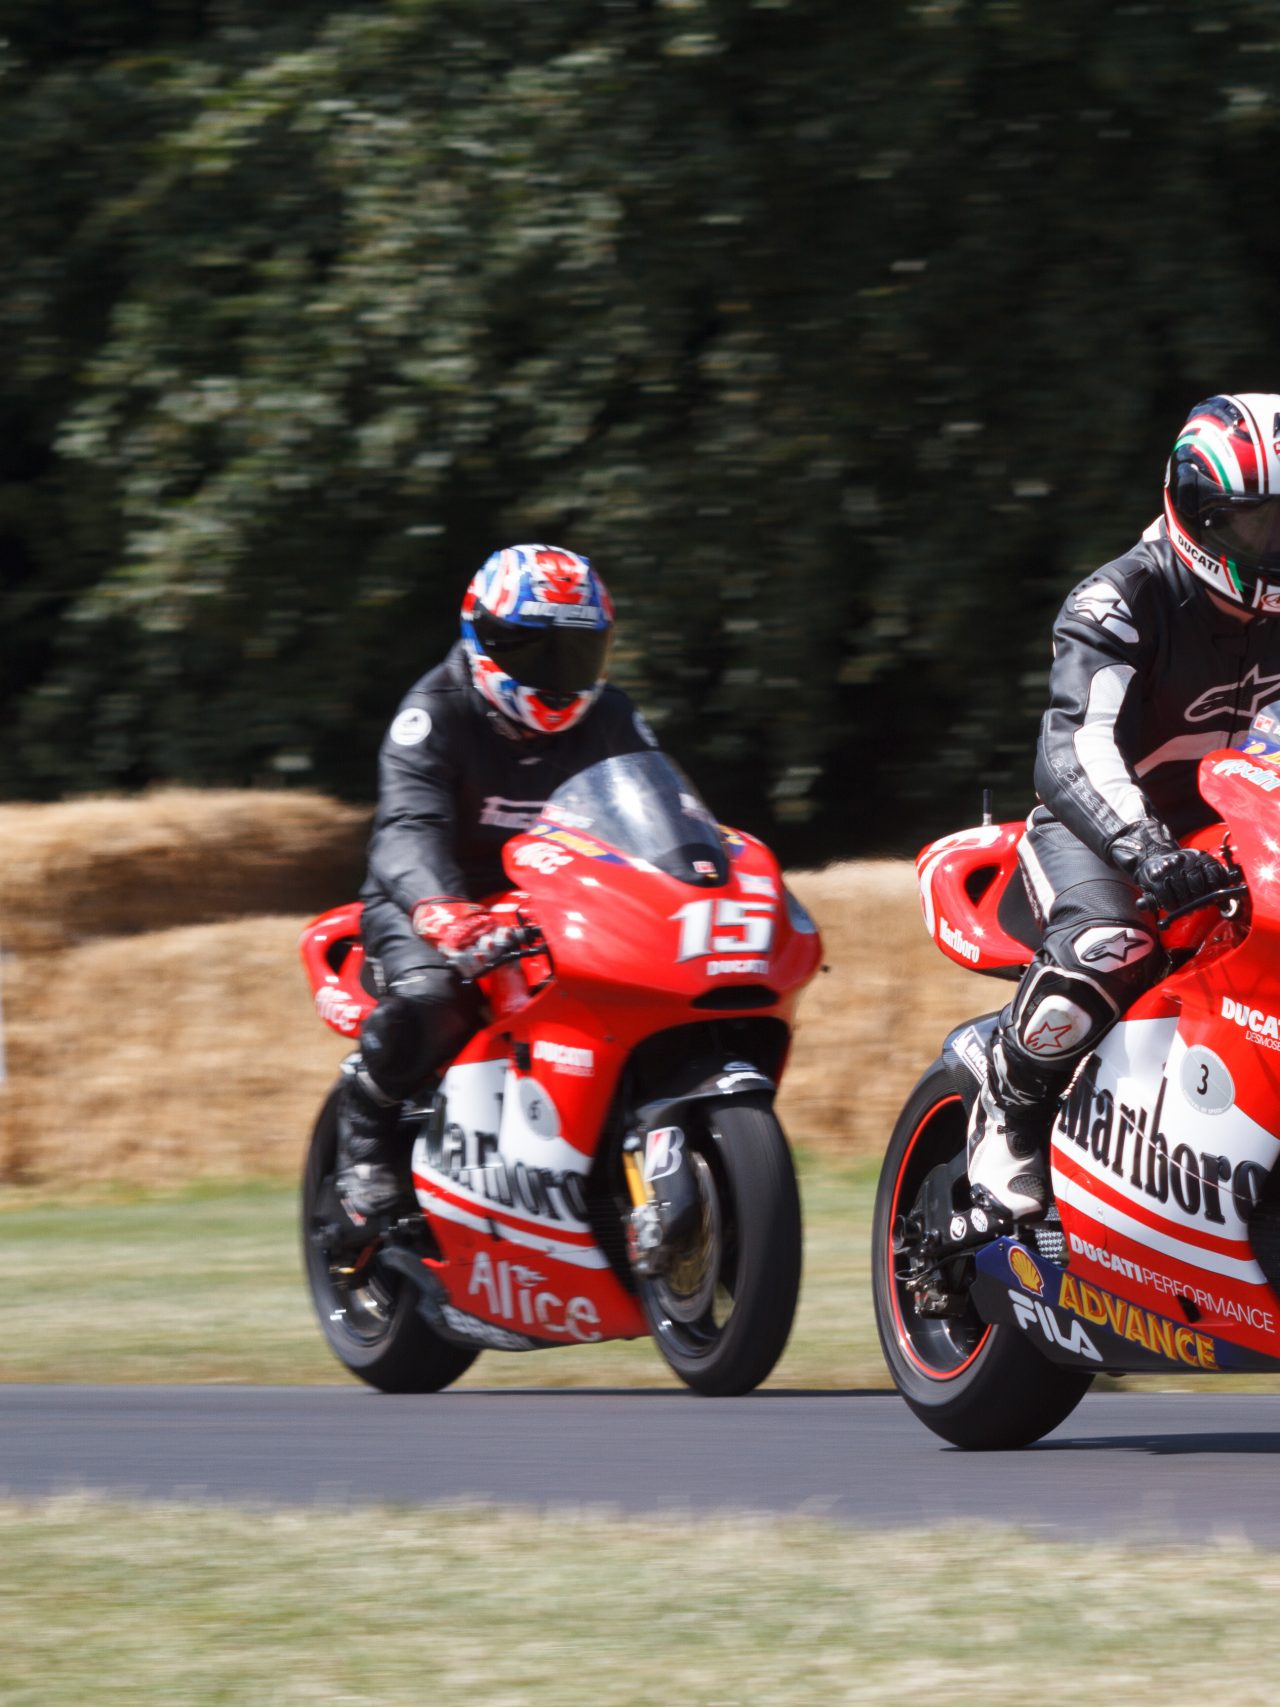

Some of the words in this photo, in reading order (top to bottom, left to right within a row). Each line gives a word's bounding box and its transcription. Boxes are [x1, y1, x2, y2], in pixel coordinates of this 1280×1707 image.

[1177, 534, 1220, 575] DUCATI
[668, 898, 777, 964] 15
[1196, 1063, 1210, 1096] 3
[467, 1250, 603, 1342] Alice
[1069, 1232, 1143, 1283] DUCATI
[1142, 1267, 1276, 1333] PERFORMANCE
[1008, 1289, 1104, 1362] FILA
[1058, 1272, 1220, 1371] ADVANCE
